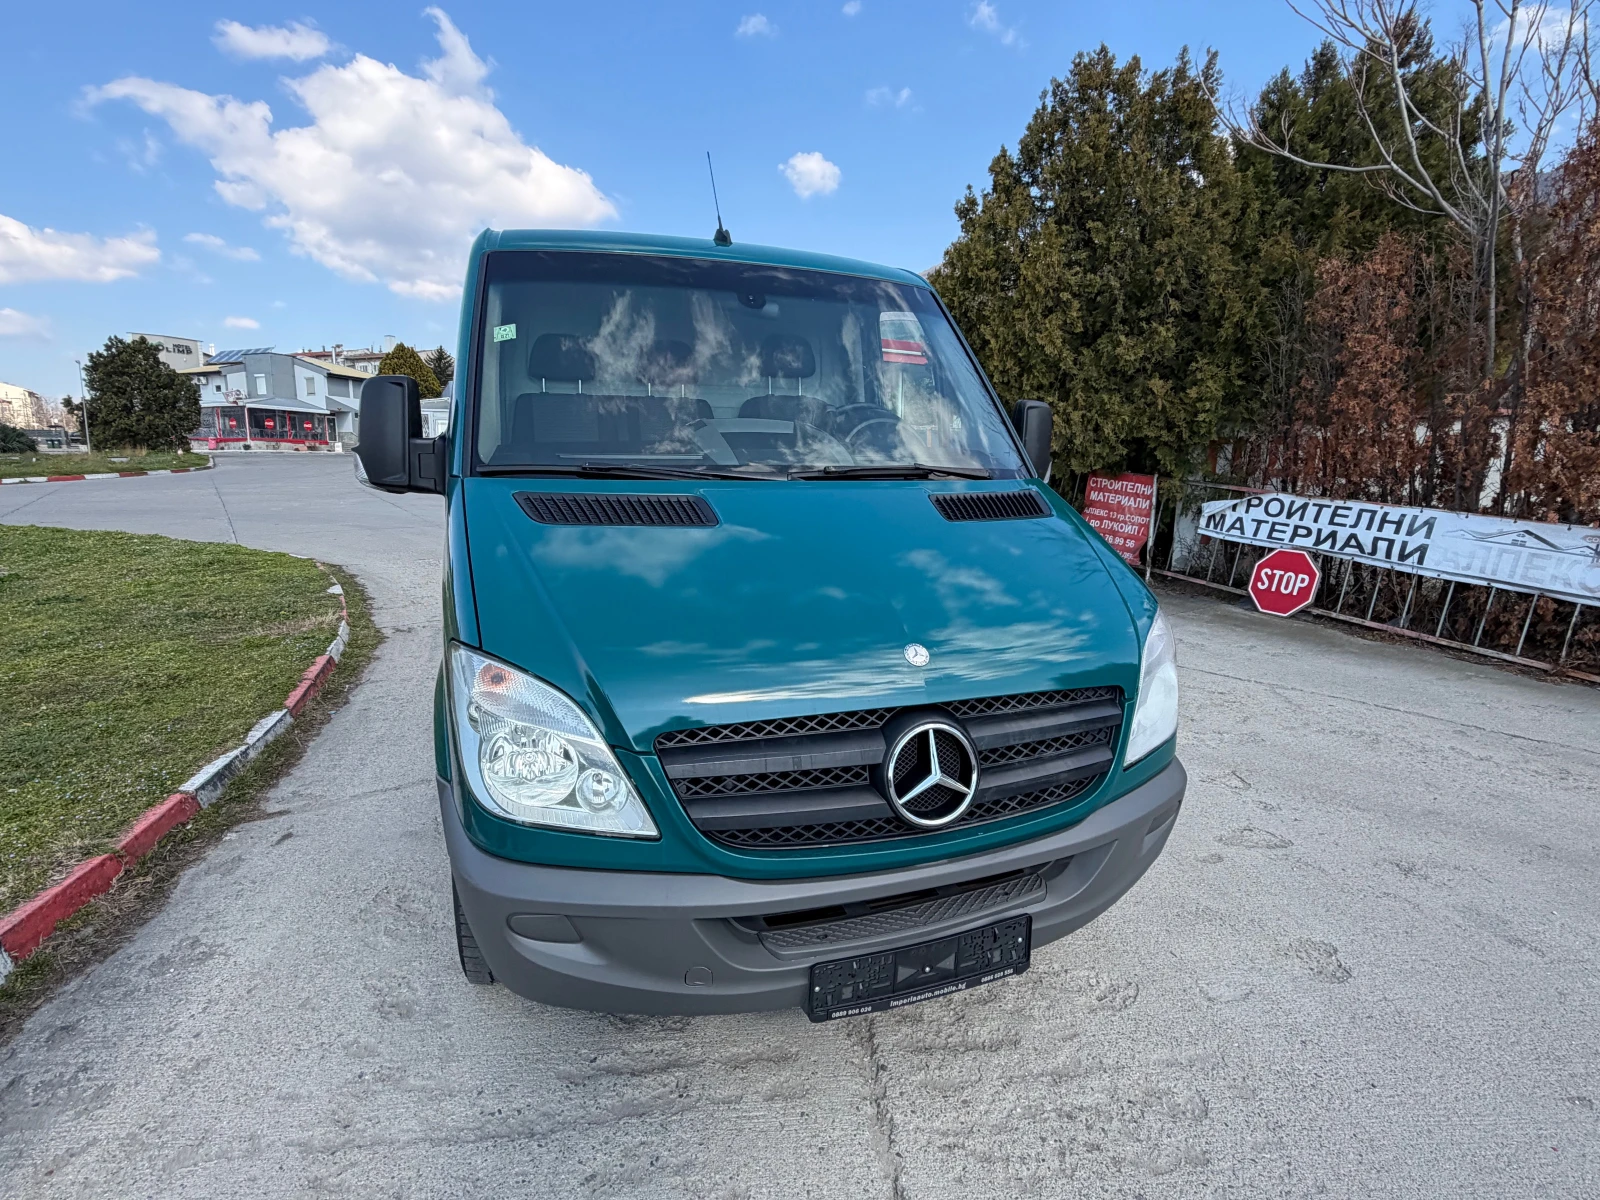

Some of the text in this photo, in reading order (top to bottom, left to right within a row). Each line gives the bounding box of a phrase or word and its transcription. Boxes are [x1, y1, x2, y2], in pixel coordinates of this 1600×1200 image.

[1089, 490, 1150, 510] МАТЕРИАЛИ
[1101, 520, 1139, 536] ЛУКОЙЛ
[1231, 496, 1437, 540] РОИТЕЛНИ
[1205, 513, 1430, 566] МАТЕРИАЛИ
[1257, 567, 1310, 596] STOP
